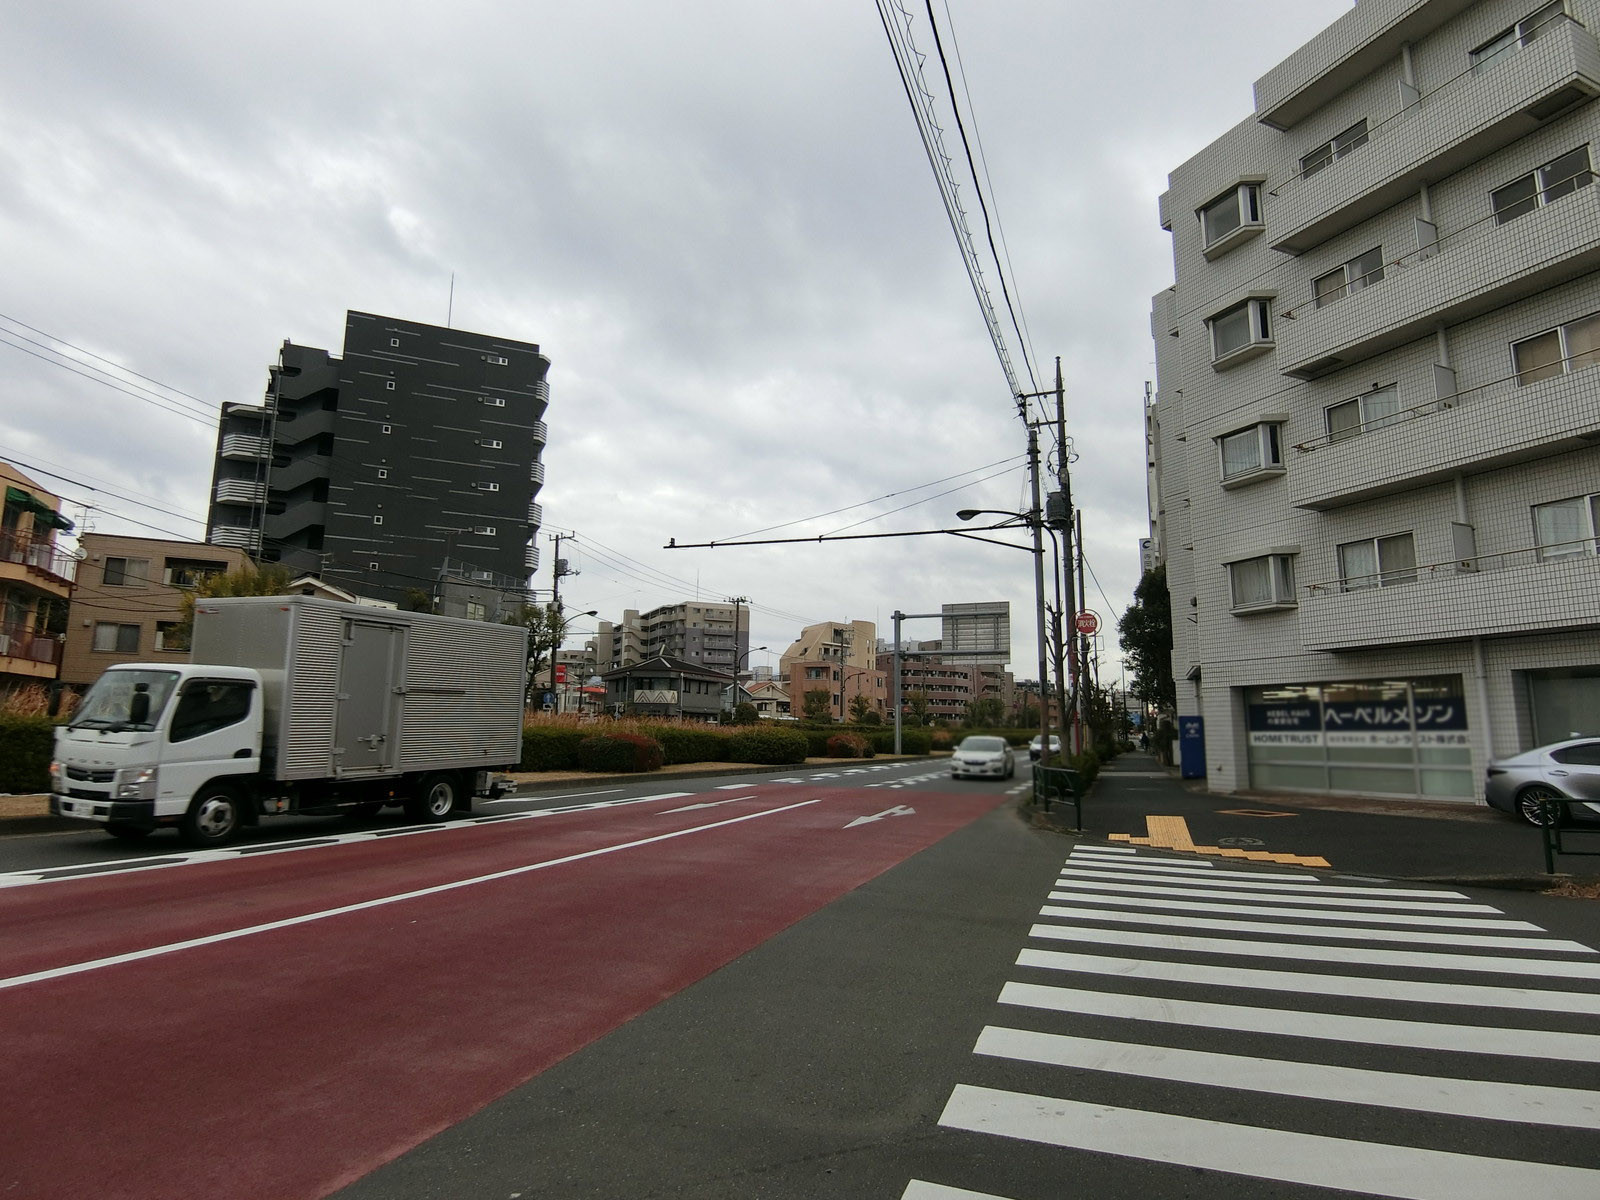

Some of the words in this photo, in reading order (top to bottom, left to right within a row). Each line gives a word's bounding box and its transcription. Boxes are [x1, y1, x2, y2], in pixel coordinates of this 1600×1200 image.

[1078, 619, 1096, 628] 消火栓
[1324, 705, 1454, 725] ヘーベルメゾン
[1253, 734, 1319, 744] HOMETRUST
